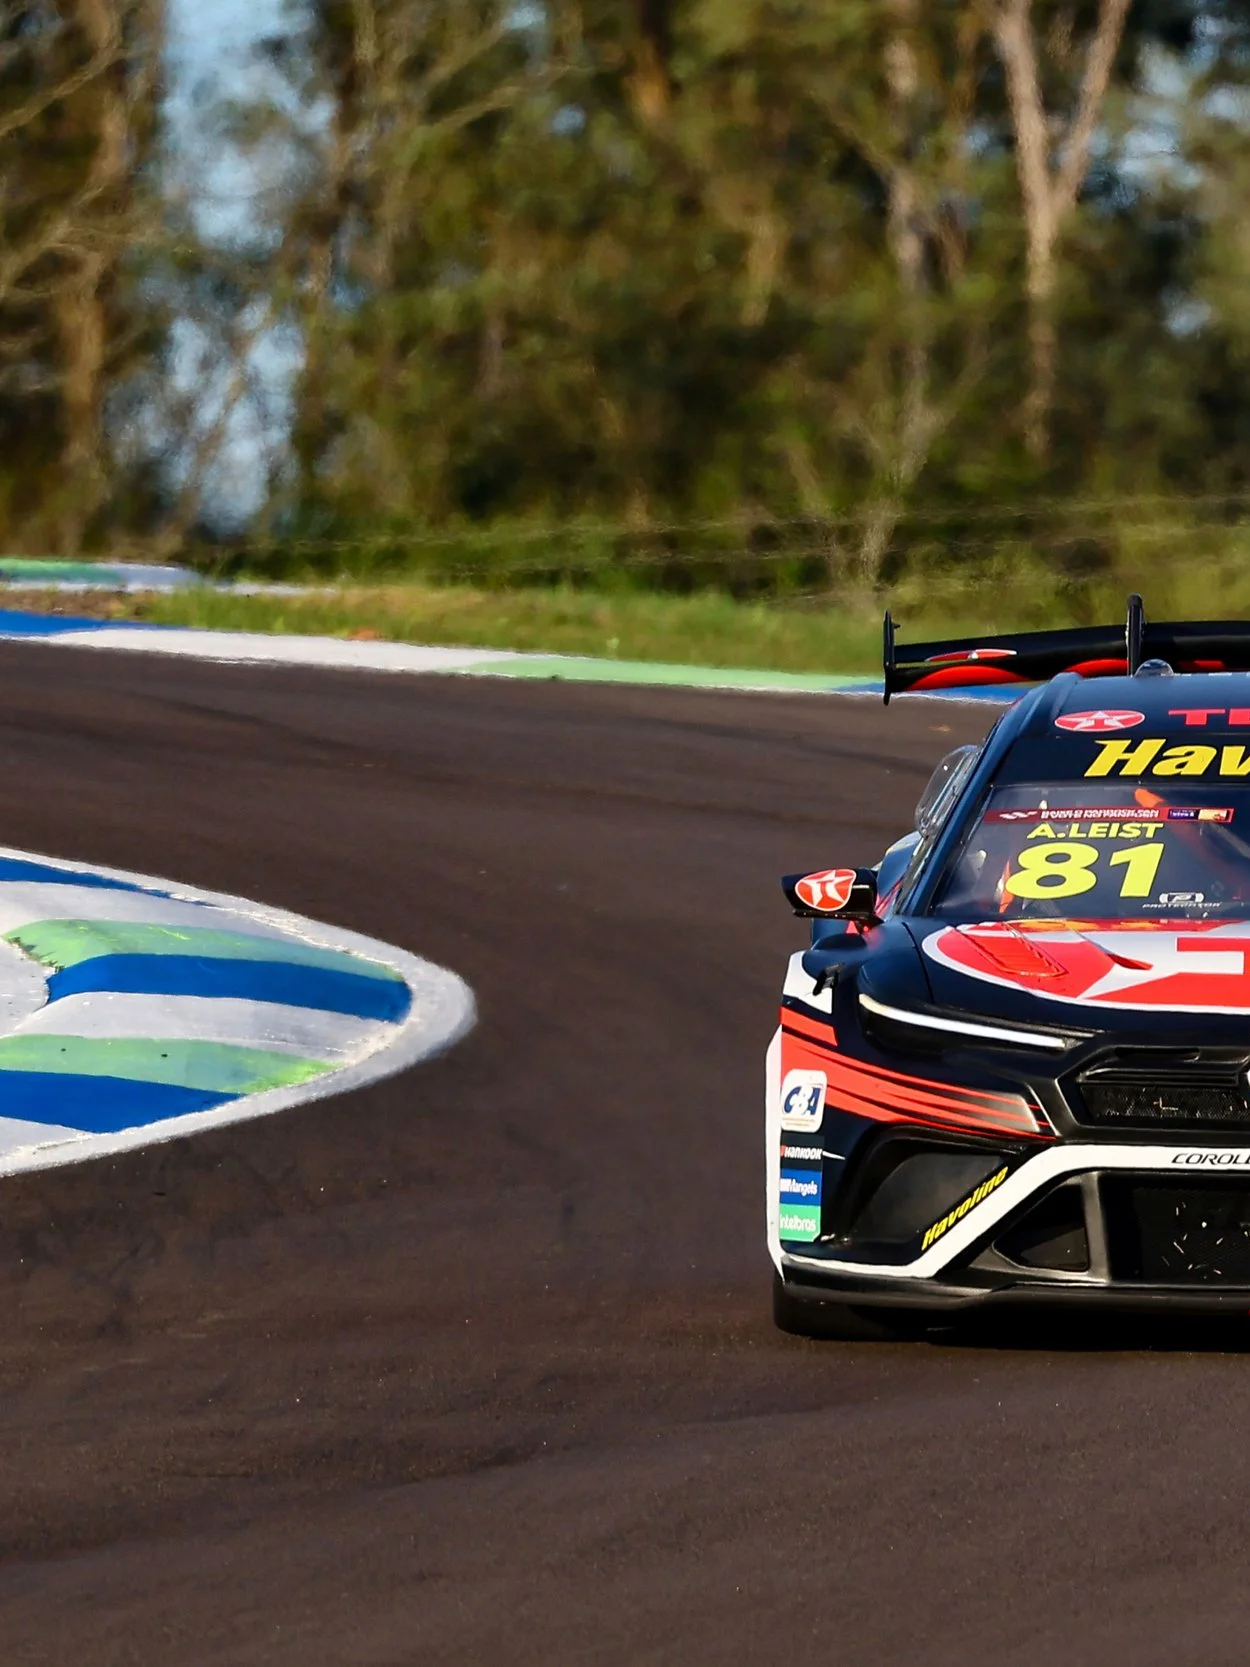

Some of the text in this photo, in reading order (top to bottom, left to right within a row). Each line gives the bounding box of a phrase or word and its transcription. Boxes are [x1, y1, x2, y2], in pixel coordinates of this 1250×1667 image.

[1026, 822, 1164, 839] A.LEIST
[1005, 841, 1166, 900] 81
[784, 1085, 823, 1115] CBA
[921, 1166, 1009, 1251] Havoline
